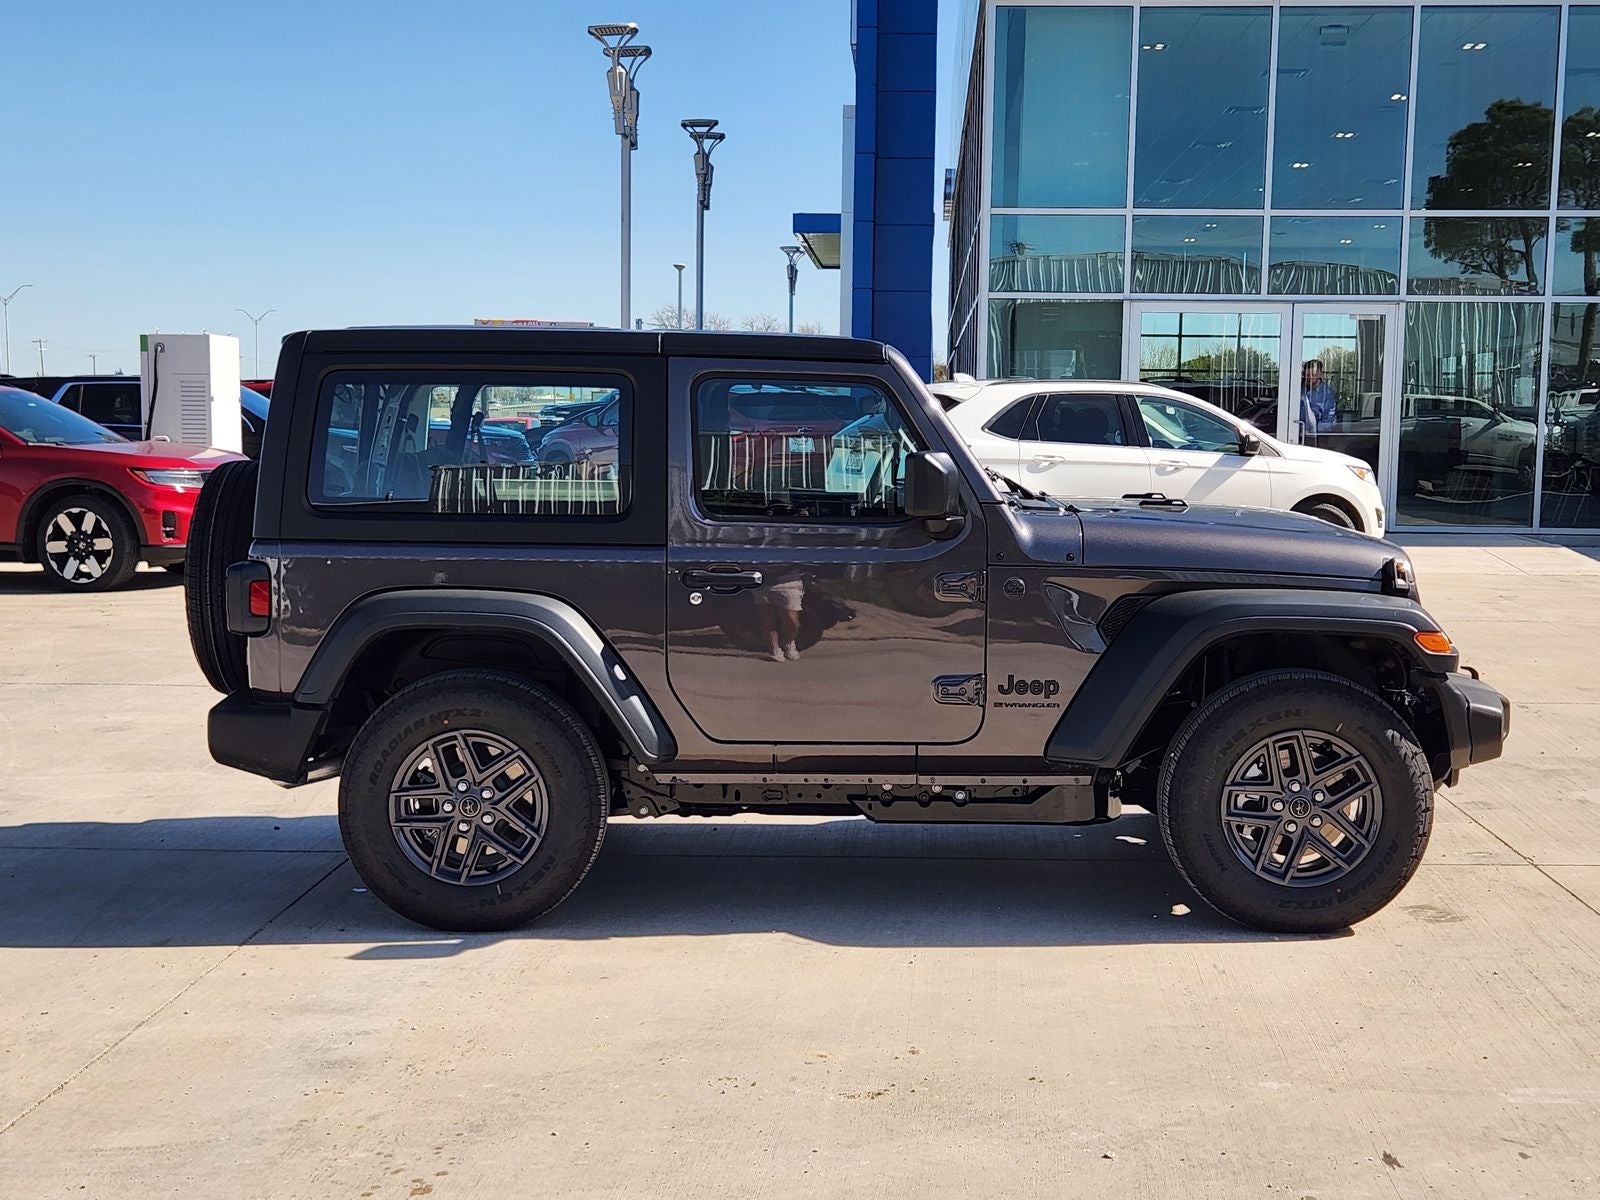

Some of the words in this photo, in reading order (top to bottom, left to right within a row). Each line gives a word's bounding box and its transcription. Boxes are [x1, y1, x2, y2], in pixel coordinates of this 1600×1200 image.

[997, 674, 1060, 699] Jeep
[368, 716, 425, 786] ROADIAN
[430, 708, 482, 723] HTX2
[1219, 708, 1302, 757] NEXEN
[479, 853, 557, 908] NEXEN
